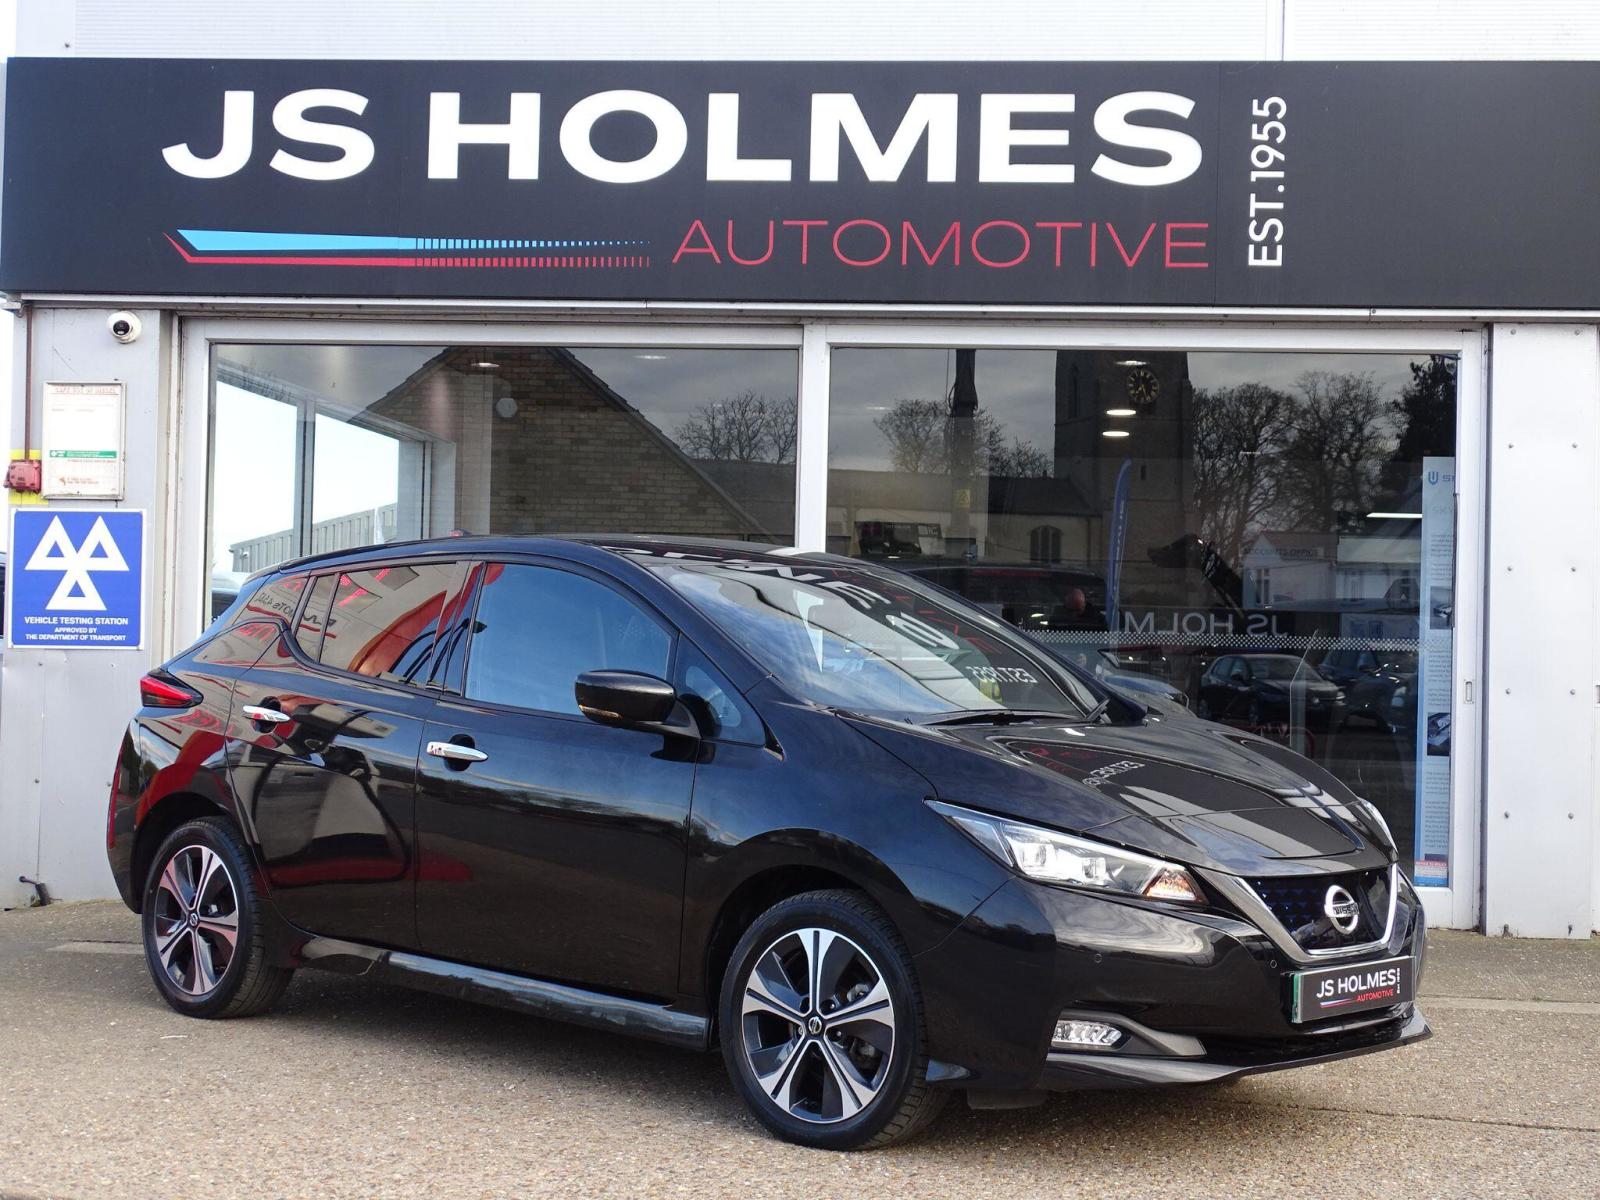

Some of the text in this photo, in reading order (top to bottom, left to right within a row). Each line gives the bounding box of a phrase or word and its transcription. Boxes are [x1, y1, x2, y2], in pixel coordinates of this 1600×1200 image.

[161, 88, 1204, 187] JS HOLMES
[1246, 96, 1288, 269] EST.1955
[671, 218, 1210, 269] AUTOMOTIVE
[24, 616, 129, 626] VEHICLE TESTING STATION
[25, 633, 36, 641] THE
[38, 633, 79, 641] DEPARTMENT
[90, 634, 127, 642] TRANSPORT
[1316, 978, 1335, 998] JS
[1337, 968, 1396, 995] HOLMES
[1356, 988, 1394, 1002] AUTOMOTIVE
